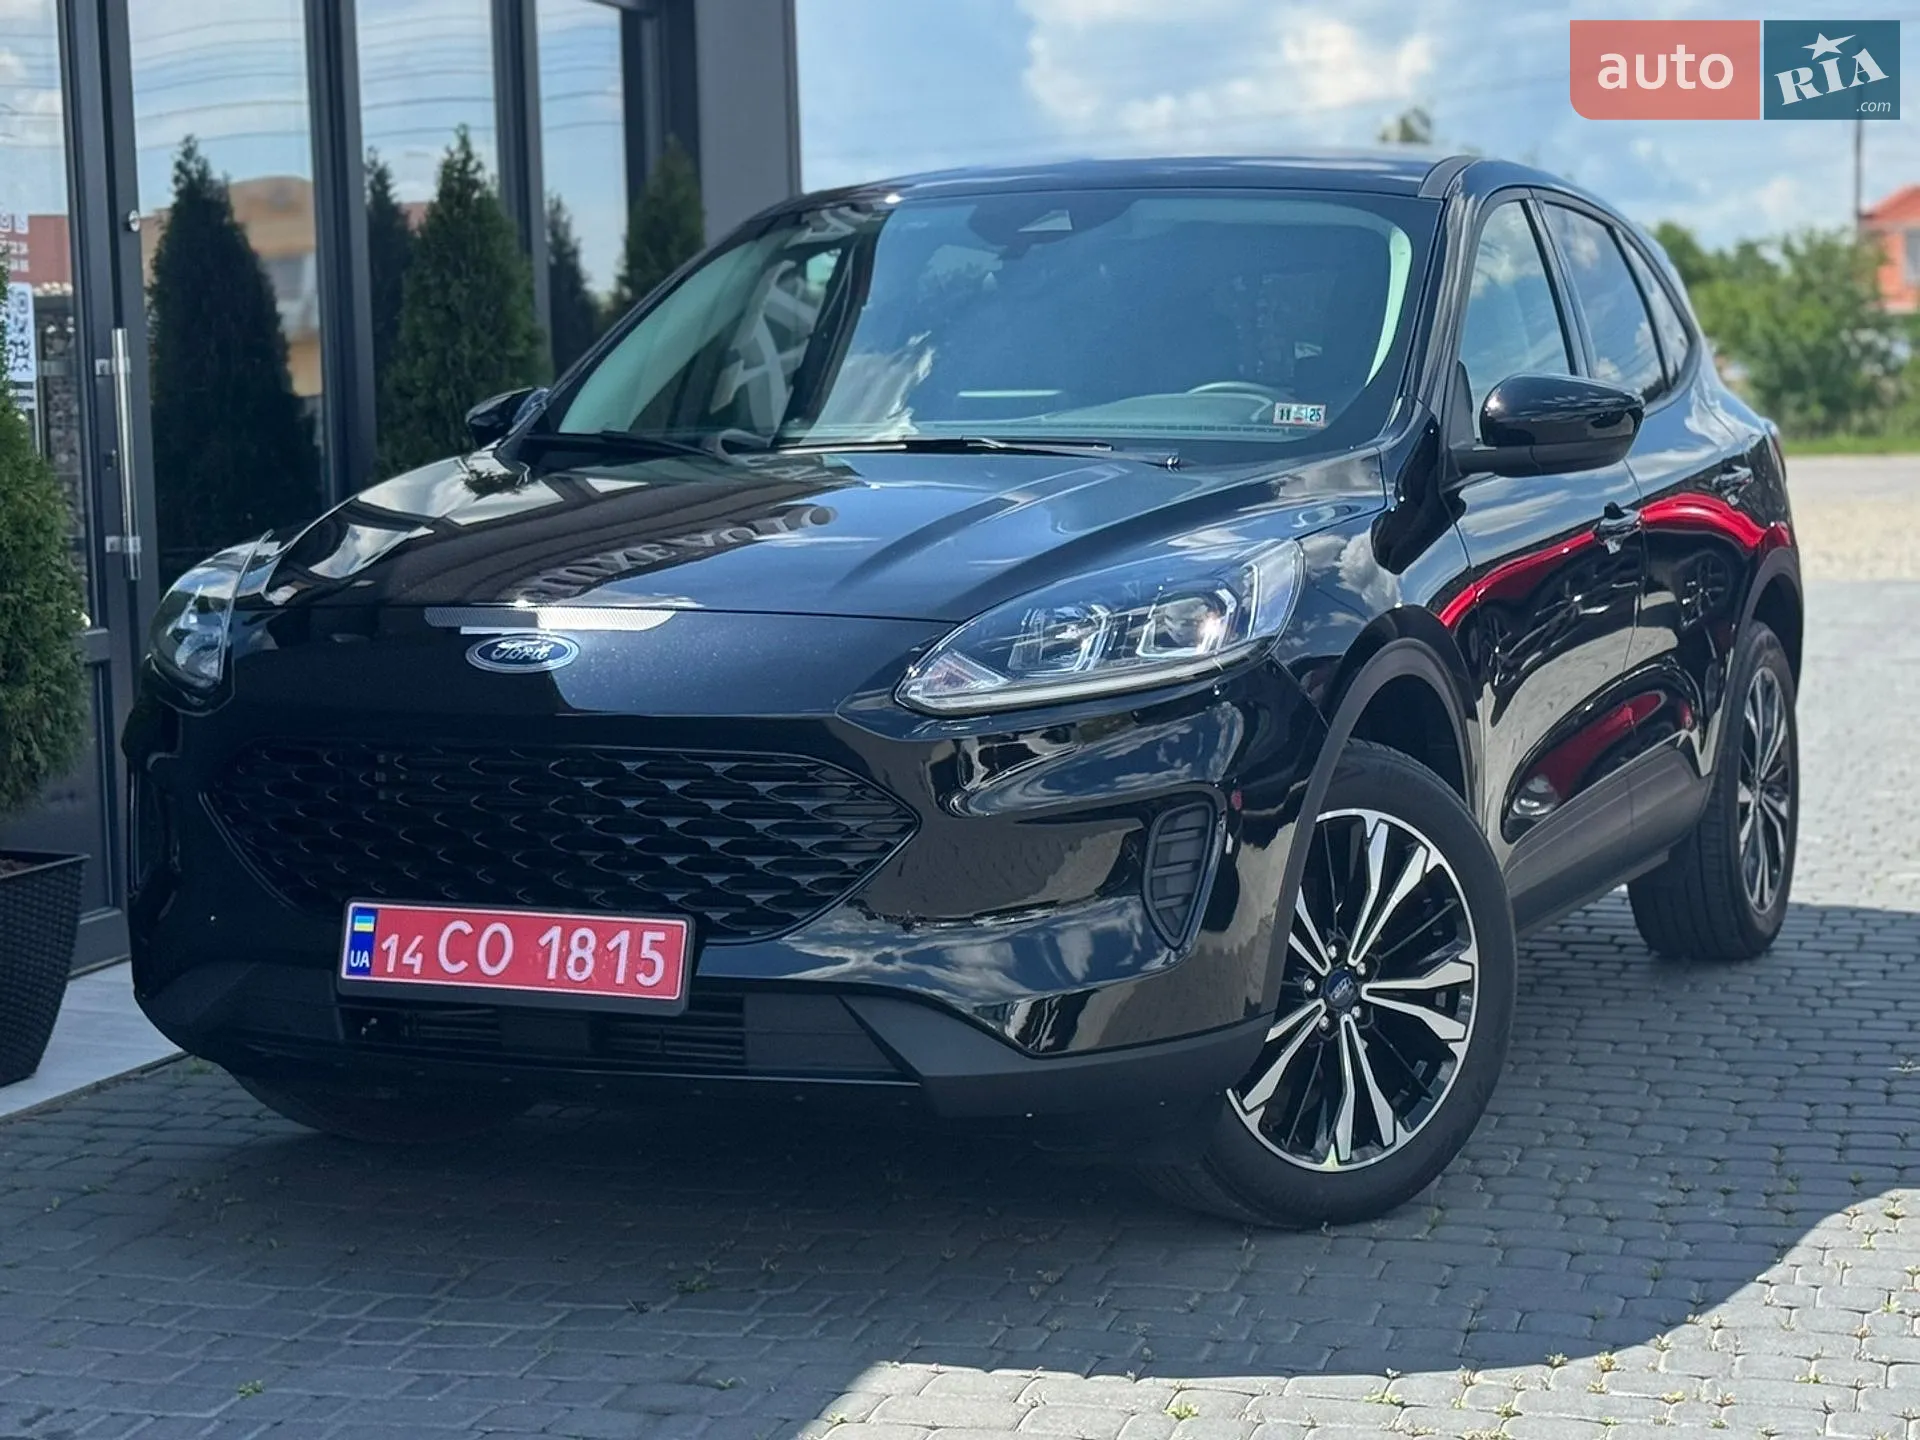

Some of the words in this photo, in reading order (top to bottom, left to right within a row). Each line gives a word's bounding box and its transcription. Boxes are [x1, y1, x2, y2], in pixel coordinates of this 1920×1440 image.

[1309, 407, 1321, 422] 25
[490, 640, 555, 660] Ford
[350, 950, 370, 968] UA
[381, 933, 424, 975] 14
[437, 920, 515, 977] CO
[537, 925, 667, 987] 1815
